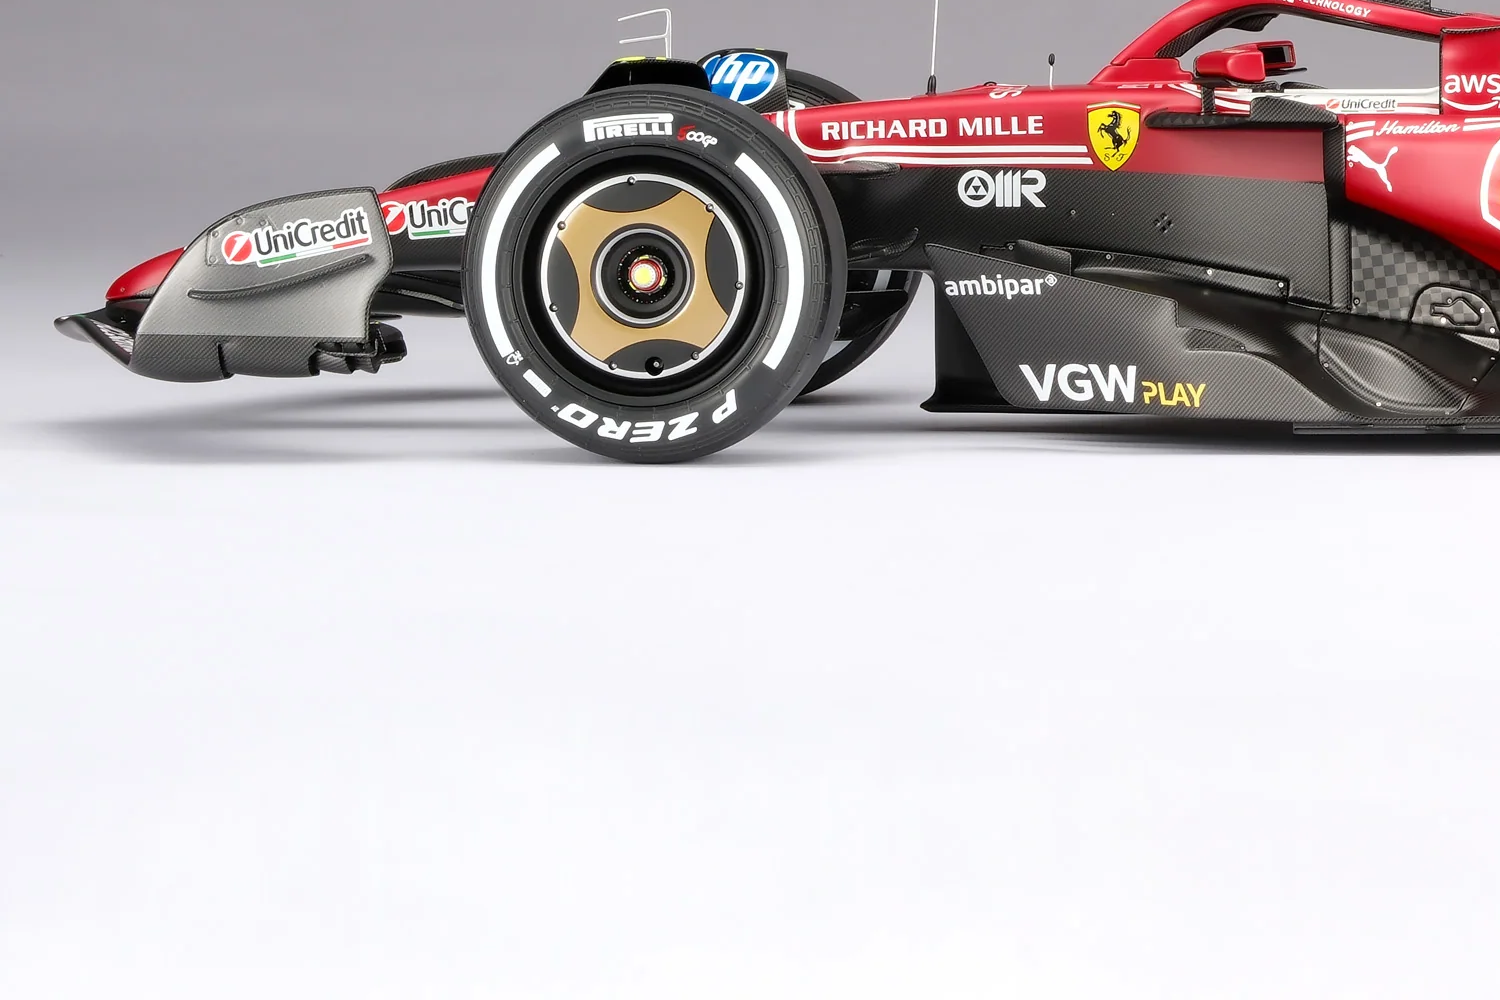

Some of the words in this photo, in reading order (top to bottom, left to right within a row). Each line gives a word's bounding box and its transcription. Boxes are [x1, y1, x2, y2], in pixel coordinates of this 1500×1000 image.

[711, 53, 770, 102] hp
[1340, 98, 1396, 110] UniCredit
[583, 112, 674, 143] PIRELLI
[821, 116, 948, 141] RICHARD
[958, 115, 1044, 137] MILLE
[1375, 119, 1461, 137] Hamilton
[254, 210, 368, 257] UniCredit
[944, 274, 1045, 300] ambipar
[1018, 363, 1137, 404] VGW
[1141, 381, 1207, 408] PLAY
[557, 402, 700, 444] ZERO
[711, 388, 739, 425] P
